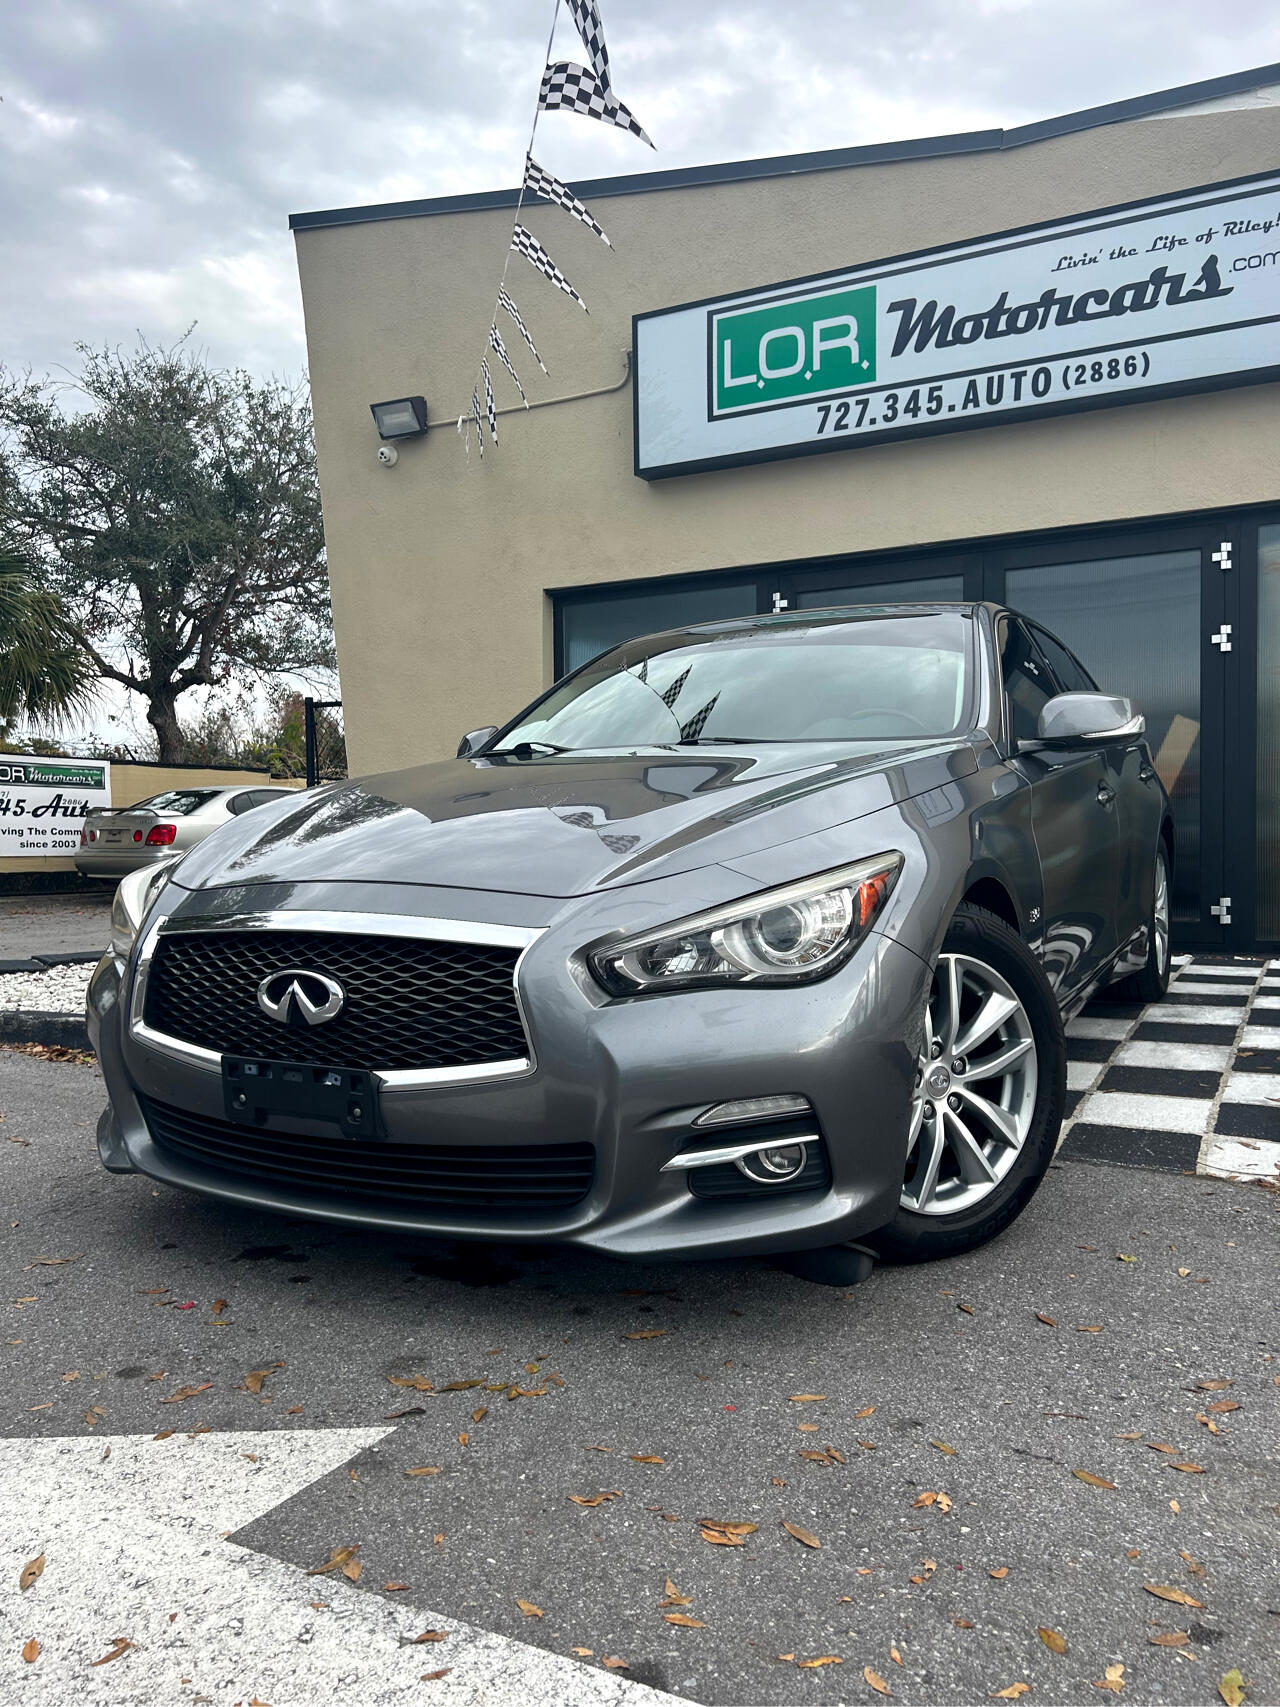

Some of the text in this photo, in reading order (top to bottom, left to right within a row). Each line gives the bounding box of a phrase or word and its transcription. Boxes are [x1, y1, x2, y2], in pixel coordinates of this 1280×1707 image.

[1051, 249, 1102, 272] Livin'
[1109, 246, 1138, 260] the
[1145, 235, 1189, 252] Life
[1195, 227, 1219, 244] of
[723, 251, 1280, 389] L.O.R. Motorcars .com
[816, 351, 1150, 434] 727.345.AUTO (2886)
[28, 767, 93, 784] Motorcars
[1, 827, 82, 837] ving The Comm
[20, 840, 77, 849] since 2003
